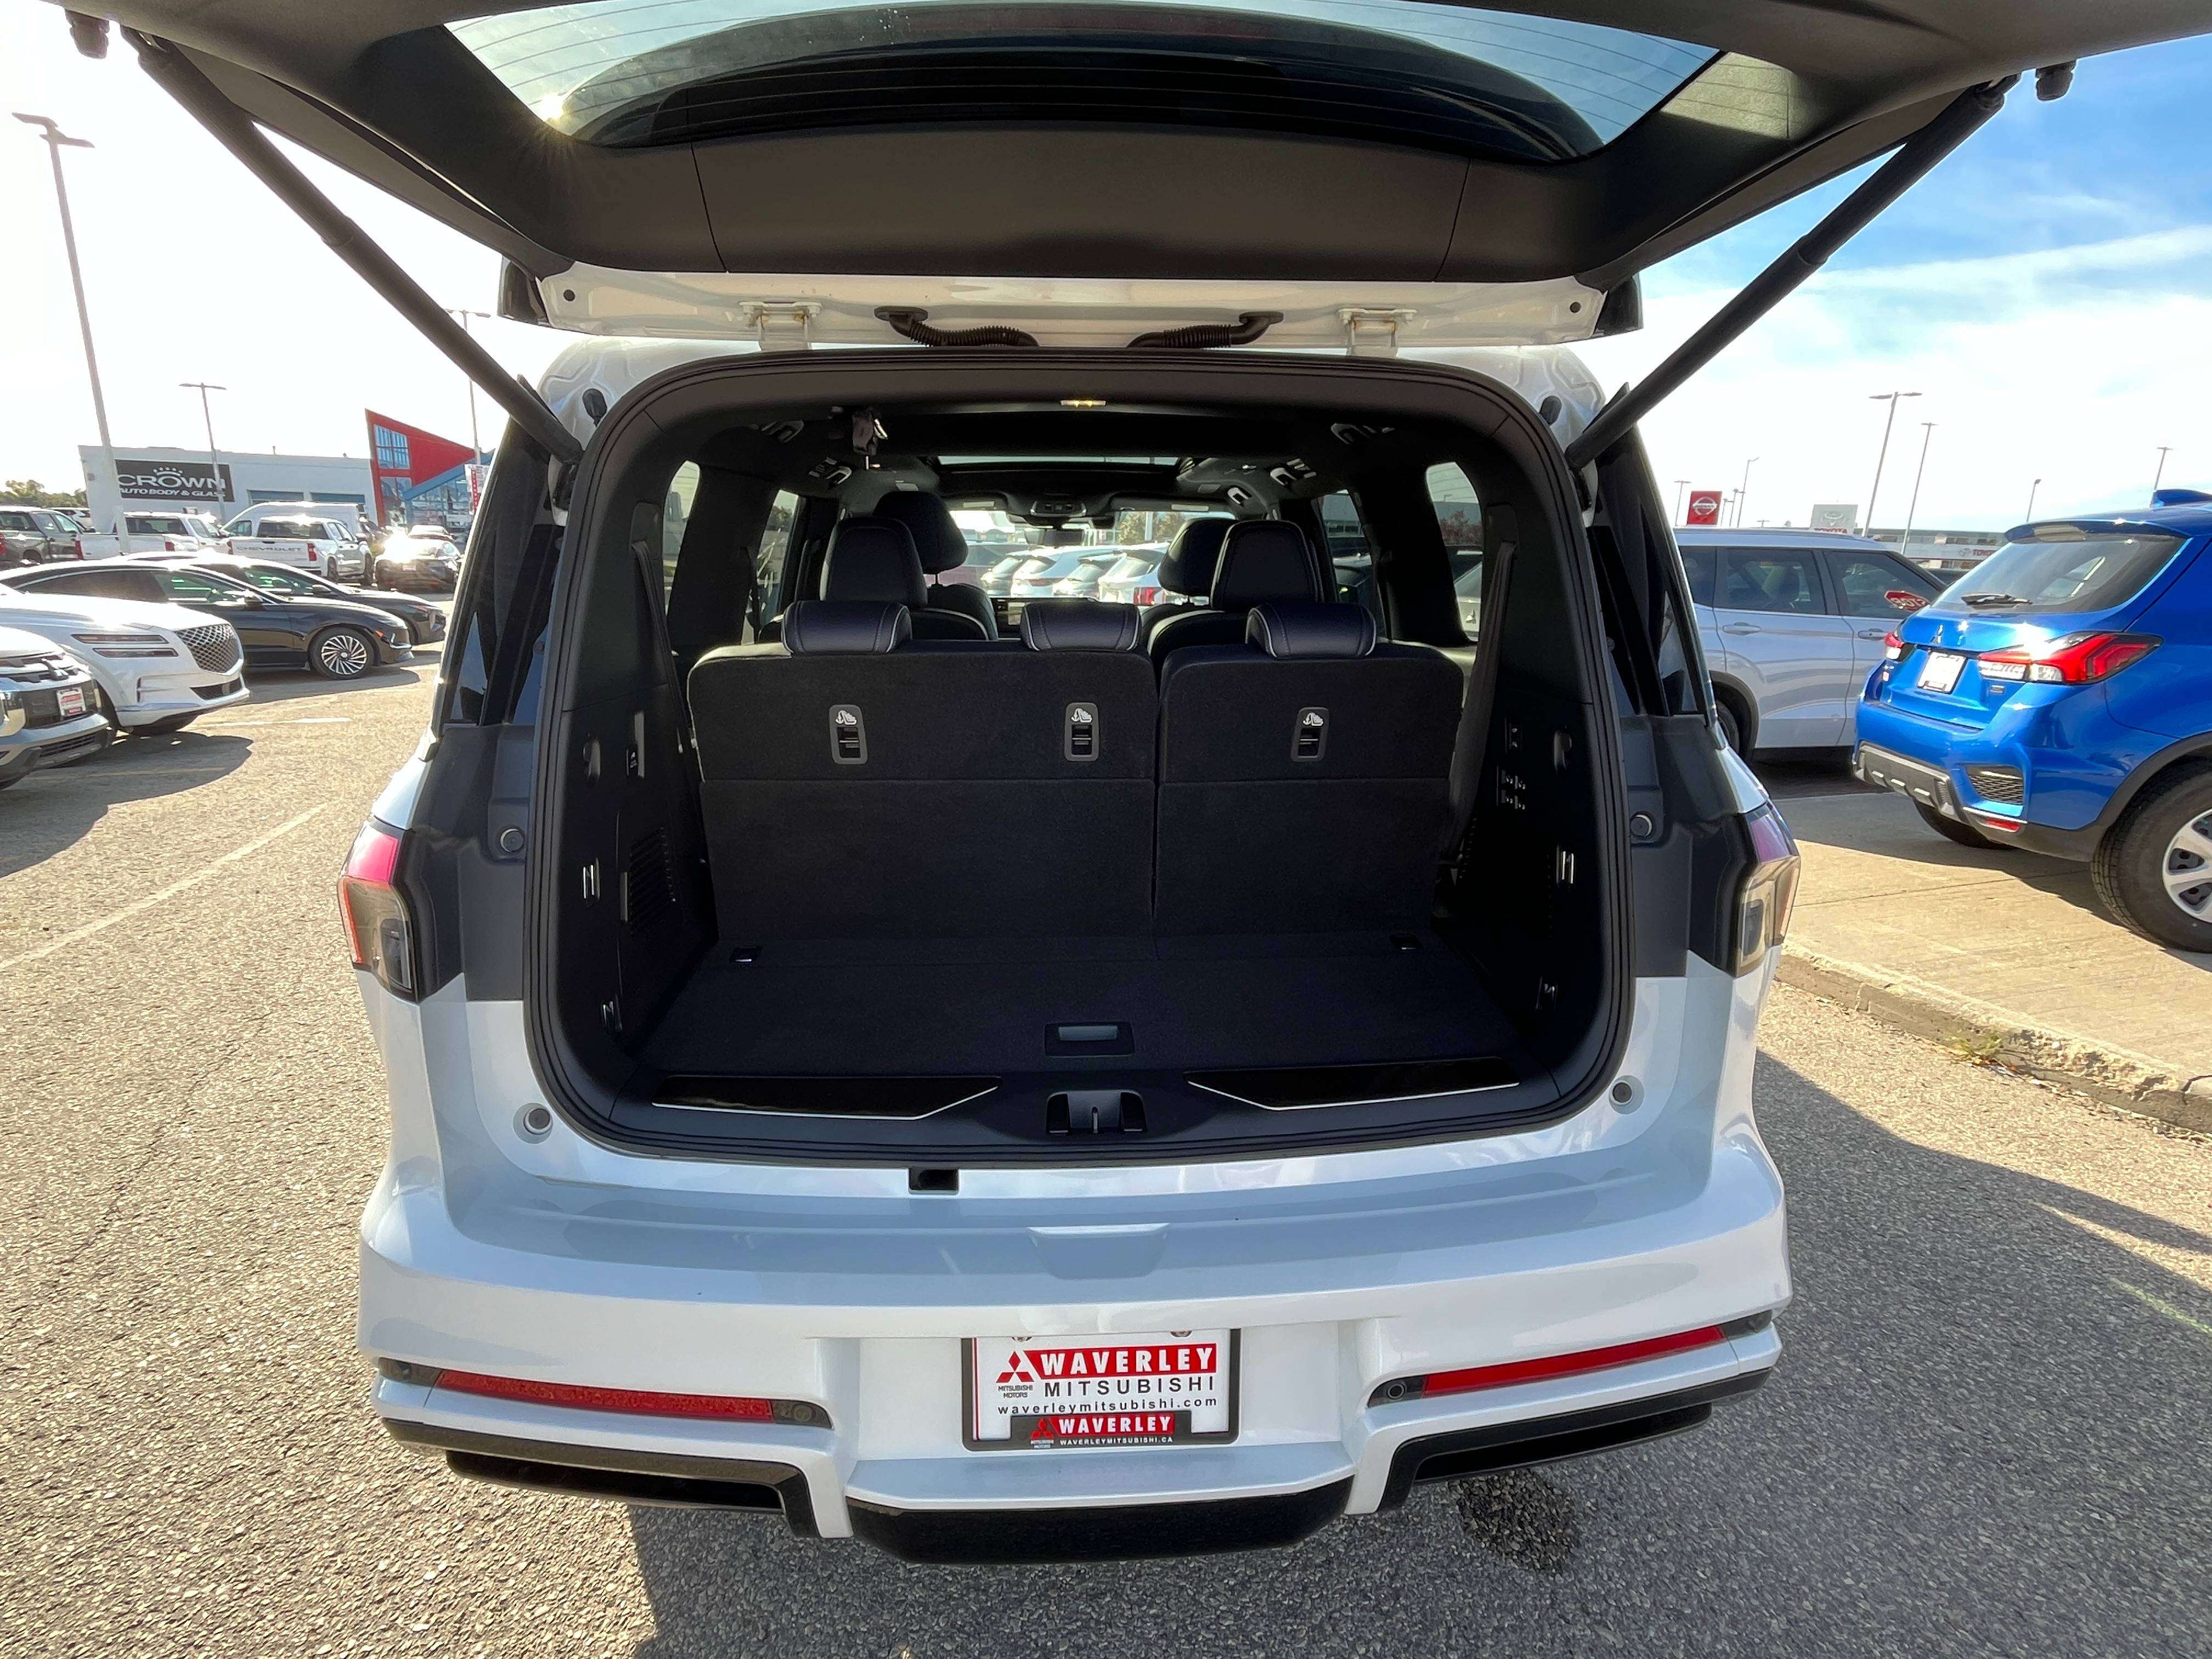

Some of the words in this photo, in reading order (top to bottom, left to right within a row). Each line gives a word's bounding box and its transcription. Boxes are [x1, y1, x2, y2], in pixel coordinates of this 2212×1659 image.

[118, 474, 226, 489] CROWN
[1040, 1347, 1212, 1376] WAVERLEY
[1045, 1376, 1213, 1397] MITSUBISHI
[998, 1398, 1217, 1414] waverleymitsubishi.com
[1059, 1417, 1171, 1434] WAVERLEY
[1060, 1437, 1173, 1445] WAVERLEYMITSUBISHI.CA
